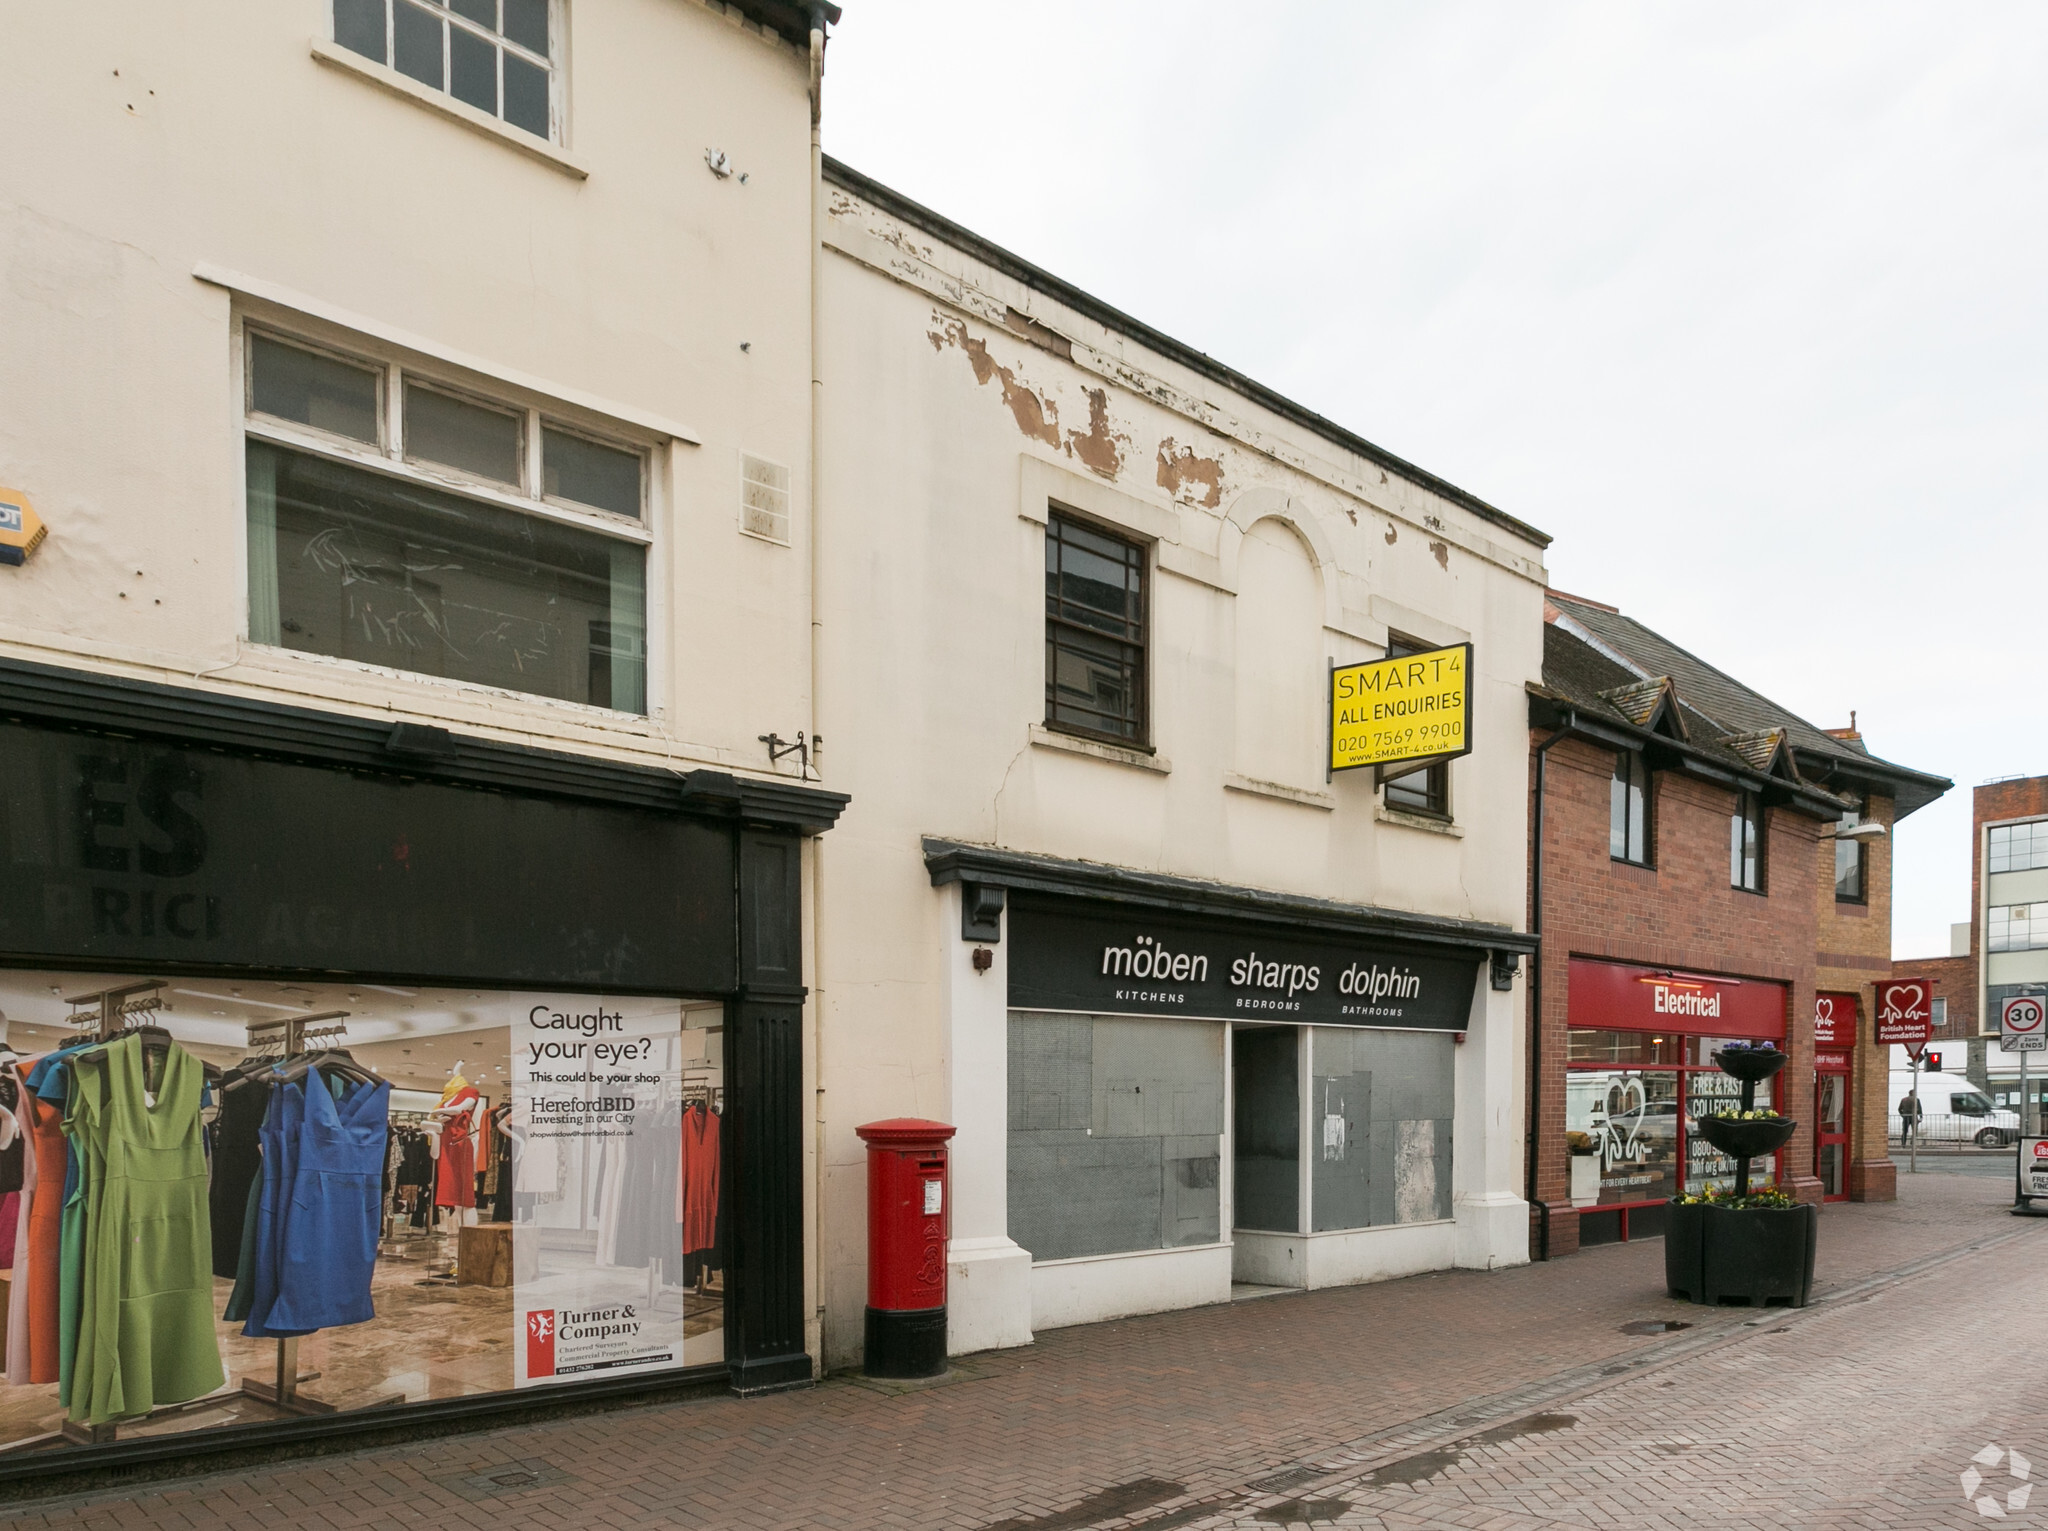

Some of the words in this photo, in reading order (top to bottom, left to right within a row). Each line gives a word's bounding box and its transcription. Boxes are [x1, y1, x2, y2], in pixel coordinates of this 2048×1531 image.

[1340, 706, 1369, 726] ALL
[1374, 691, 1462, 720] ENQUIRIES
[1338, 735, 1367, 752] 020
[1373, 728, 1413, 747] 7569
[1420, 720, 1461, 741] 9900
[1348, 741, 1449, 762] www.SMART-4.co.uk
[1102, 935, 1208, 982] möben
[1230, 952, 1320, 997] sharps
[1339, 962, 1421, 1003] dolphin
[1116, 989, 1185, 1004] KITCHENS
[1236, 998, 1300, 1011] BEDROOMS
[1342, 1005, 1403, 1017] BATHROOMS
[1654, 985, 1720, 1018] Electrical
[529, 1005, 623, 1037] Caught
[2010, 1007, 2038, 1022] 30
[1880, 1024, 1904, 1033] British
[1880, 1031, 1926, 1040] Foundation
[529, 1042, 587, 1065] your
[594, 1037, 651, 1066] eye?
[529, 1071, 552, 1082] This
[555, 1071, 586, 1082] could
[589, 1071, 604, 1082] be
[606, 1074, 631, 1085] your
[634, 1072, 660, 1085] shop
[1693, 1076, 1714, 1095] FREE
[1715, 1077, 1722, 1095] &
[531, 1097, 635, 1113] HerefordBID
[531, 1113, 583, 1126] Investing
[585, 1113, 595, 1124] in
[596, 1114, 613, 1124] our
[614, 1112, 635, 1125] City
[1692, 1141, 1712, 1157] 0800
[559, 1308, 620, 1326] Turner
[621, 1304, 637, 1319] &
[559, 1321, 641, 1340] Company
[559, 1344, 594, 1354] Chartered
[595, 1341, 628, 1349] Surveyors
[559, 1353, 600, 1363] Commercial
[601, 1347, 630, 1358] Property
[631, 1345, 669, 1354] Consultants
